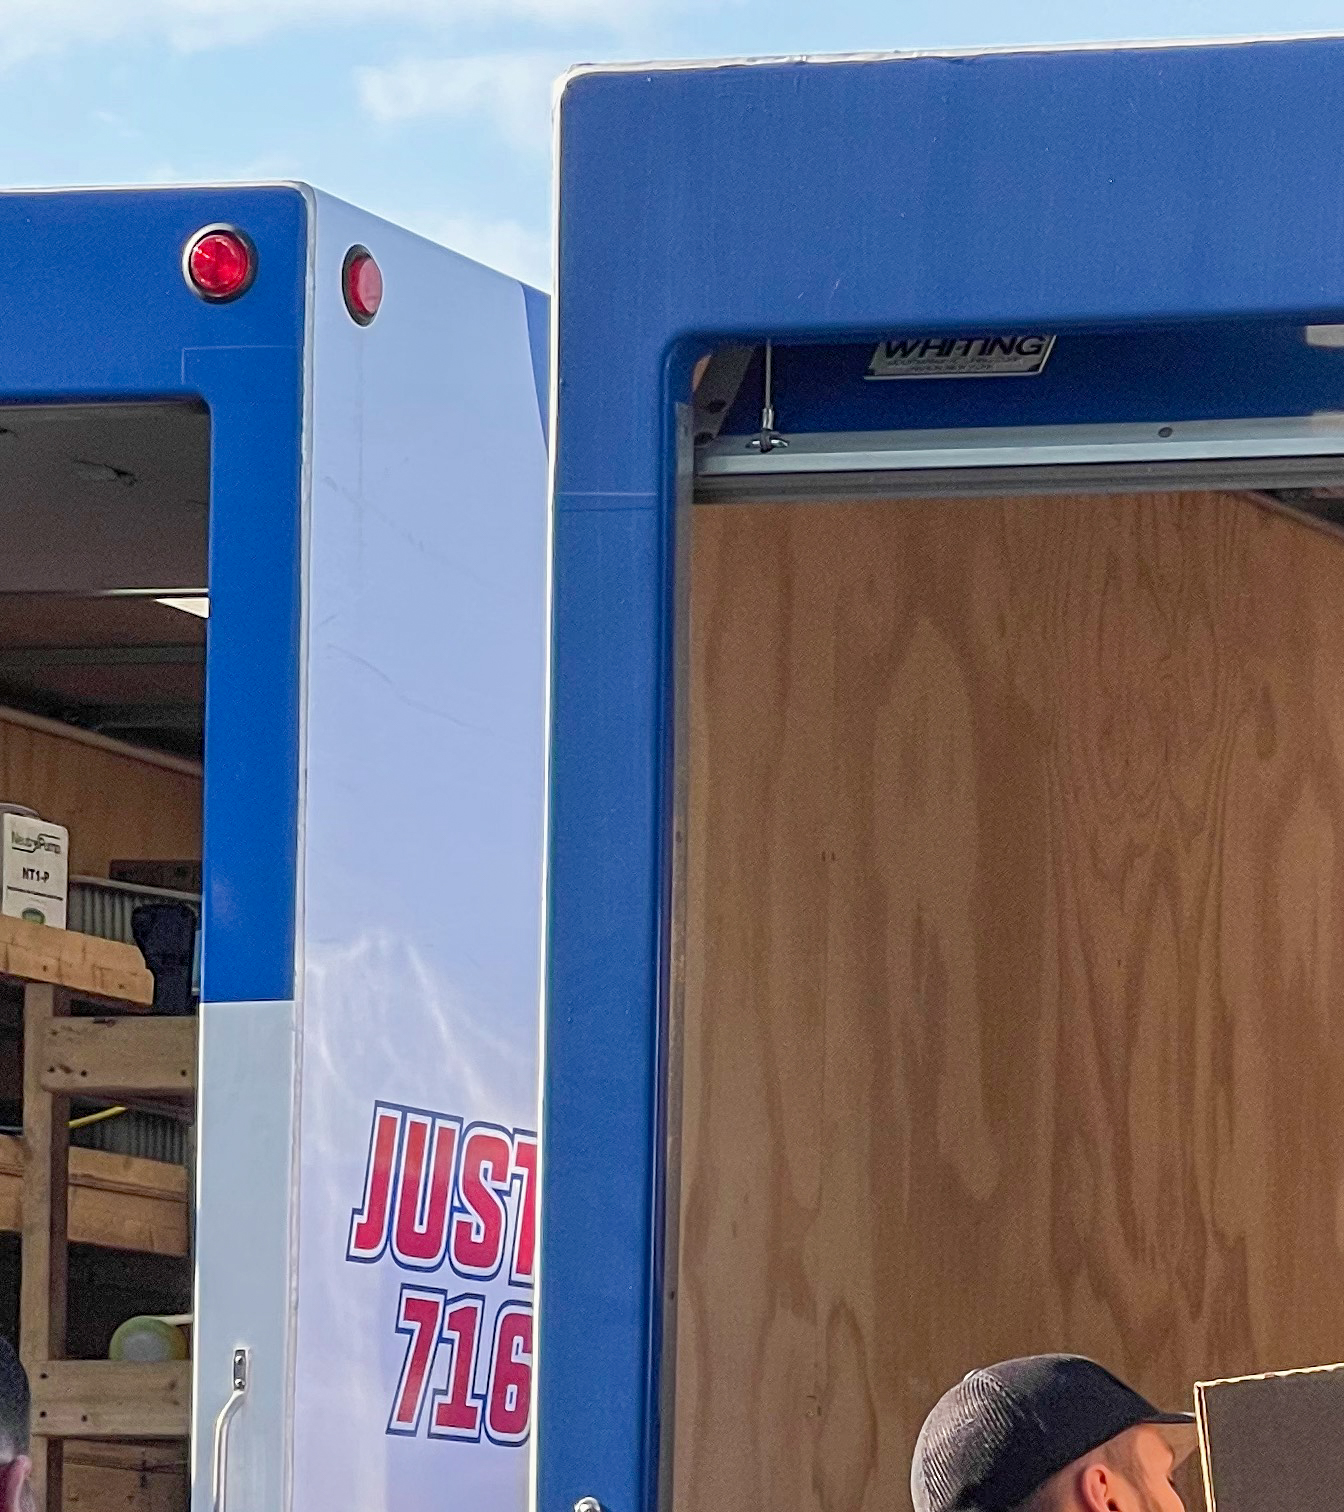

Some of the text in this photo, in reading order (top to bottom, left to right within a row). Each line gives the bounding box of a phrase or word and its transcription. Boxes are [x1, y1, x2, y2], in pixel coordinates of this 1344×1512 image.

[885, 335, 1047, 357] WHITING
[346, 1100, 538, 1287] JUST
[385, 1282, 533, 1448] 716
